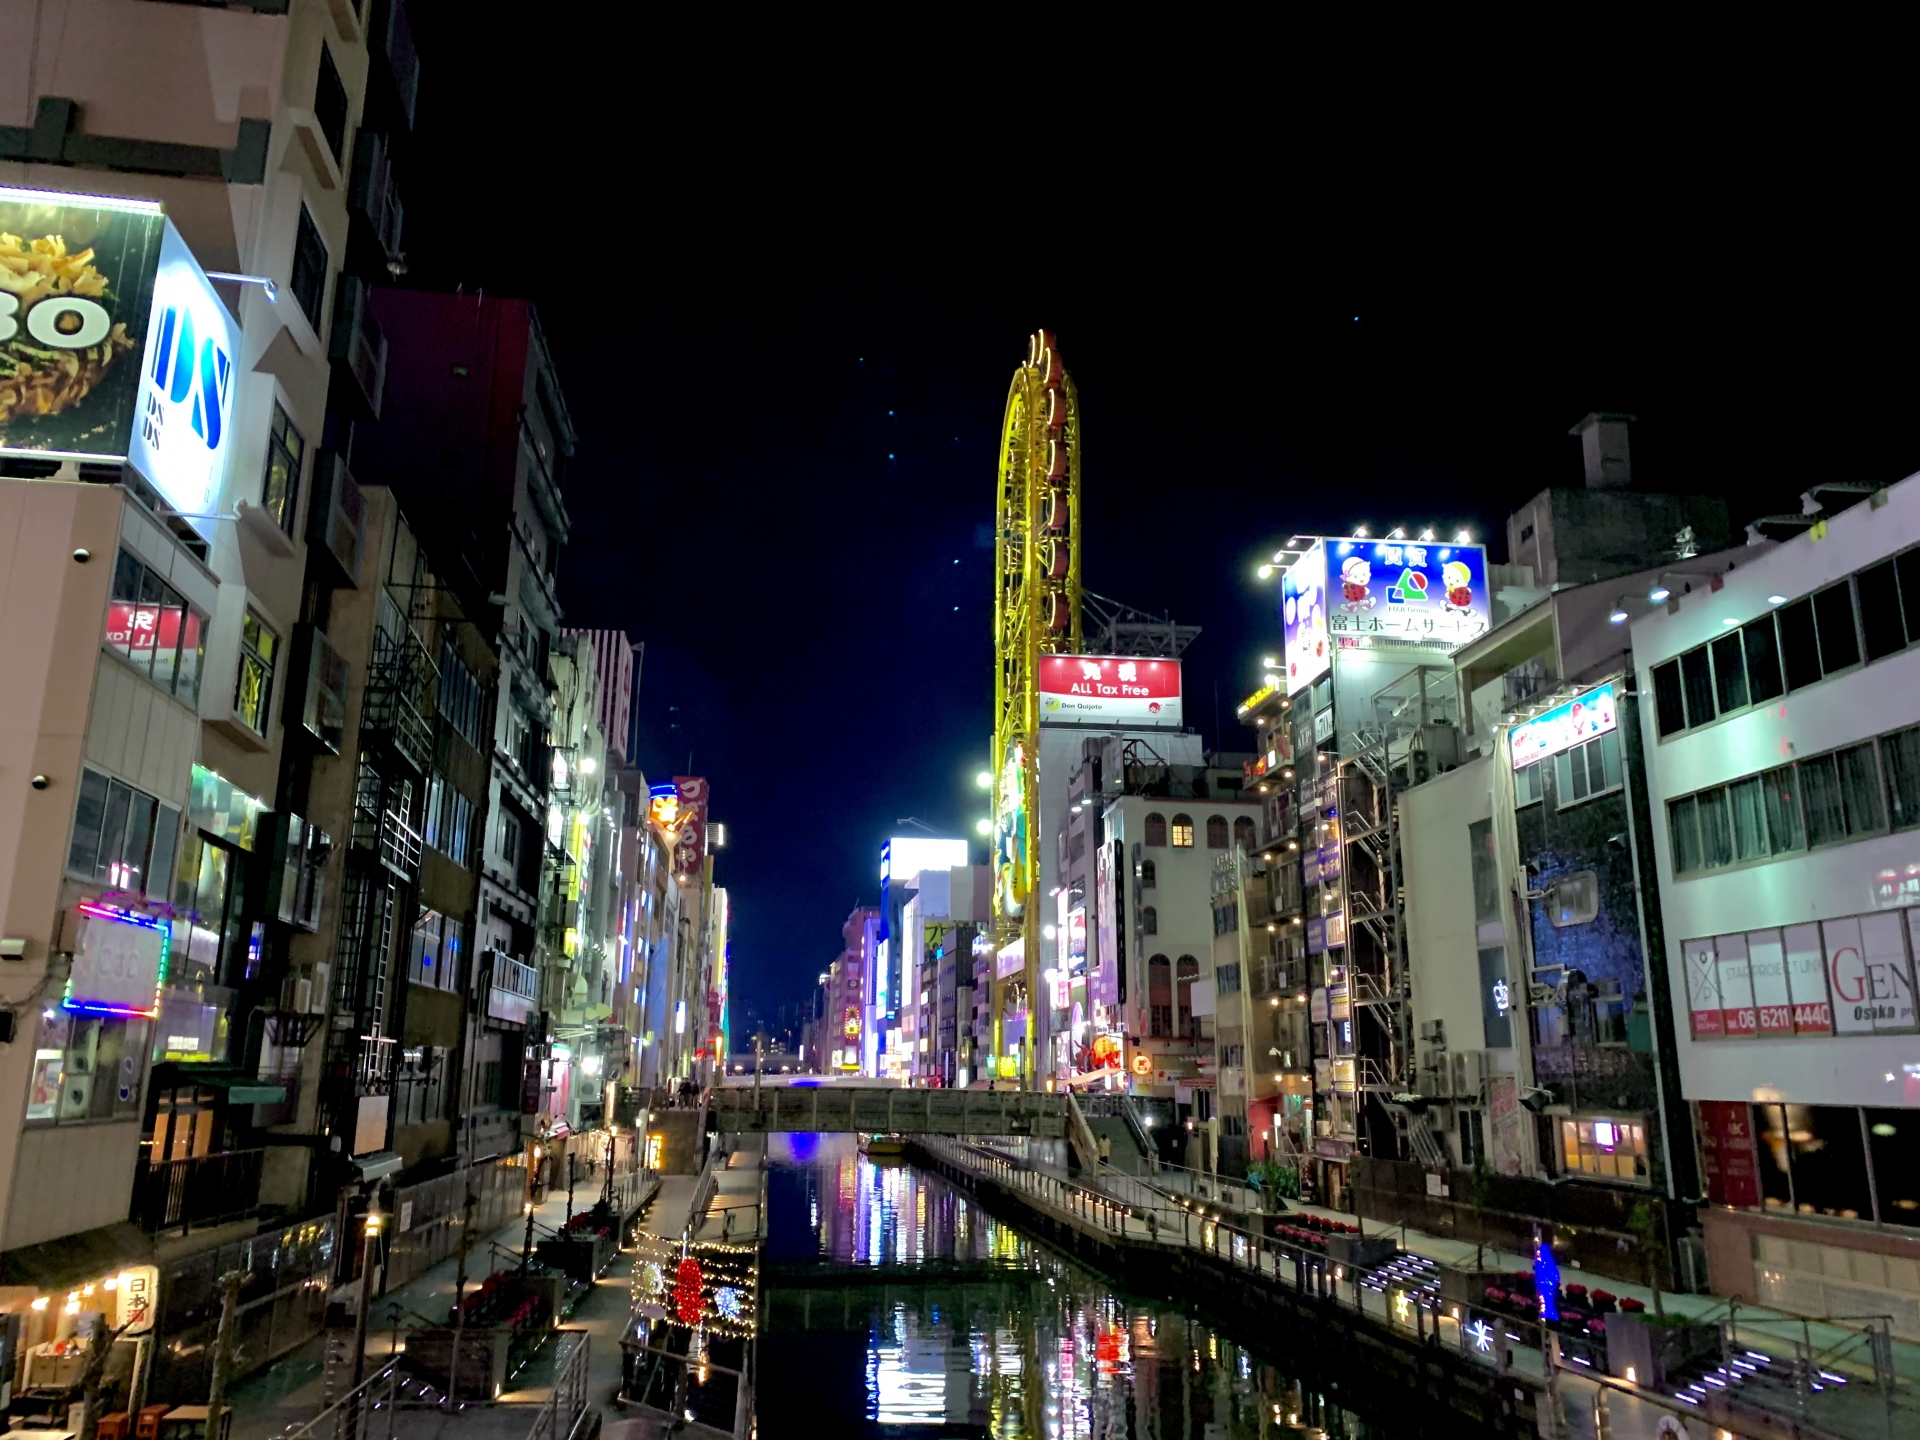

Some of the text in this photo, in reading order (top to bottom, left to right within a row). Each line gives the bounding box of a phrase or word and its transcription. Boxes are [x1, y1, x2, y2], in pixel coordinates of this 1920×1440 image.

[0, 291, 110, 348] O
[147, 391, 165, 427] DS
[142, 414, 161, 451] DS
[1071, 682, 1150, 696] ALL Tax Free
[1077, 702, 1103, 711] Quijote
[1738, 1010, 1756, 1028] 06
[1760, 1008, 1790, 1027] 6211
[1794, 1005, 1831, 1025] 4440
[1854, 1004, 1896, 1021] Osaka
